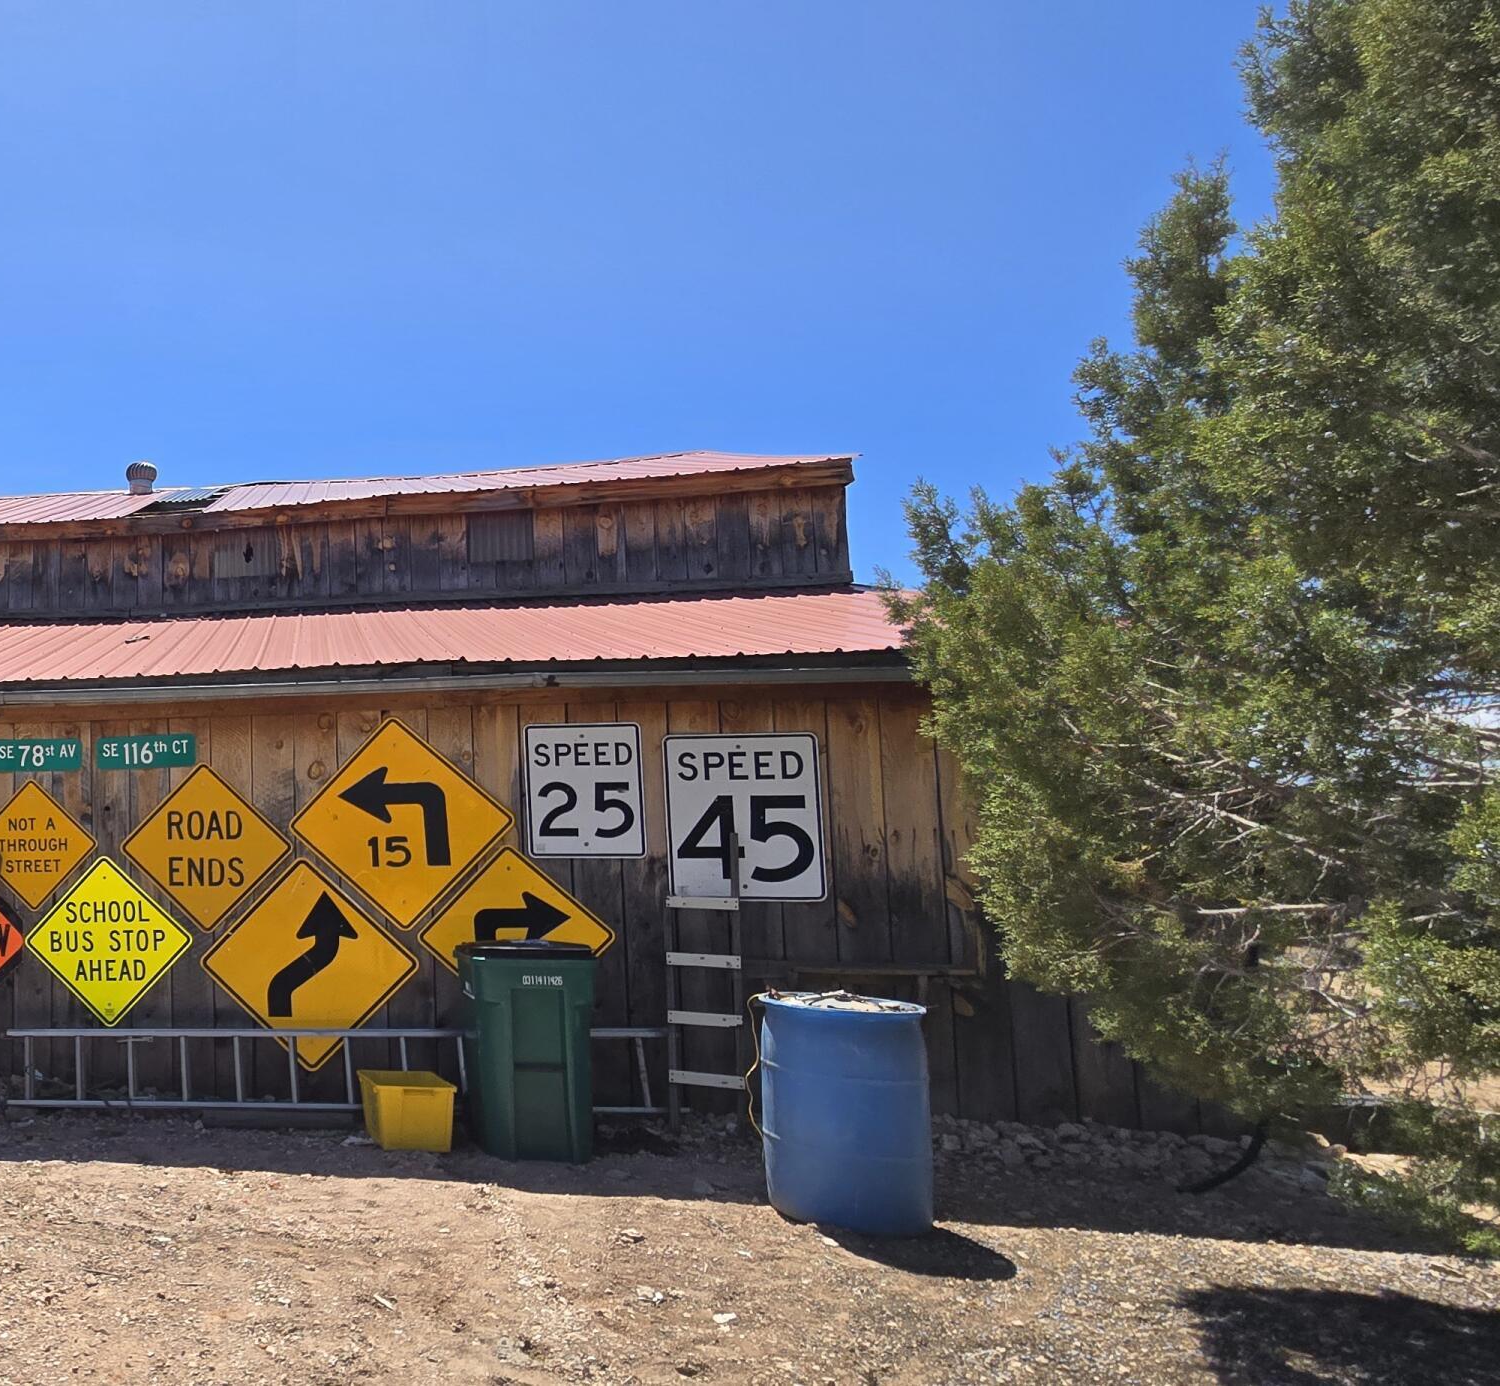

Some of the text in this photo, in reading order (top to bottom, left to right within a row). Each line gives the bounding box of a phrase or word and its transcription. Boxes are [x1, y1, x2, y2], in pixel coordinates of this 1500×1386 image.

[0, 744, 76, 767] SE 78st AV
[102, 740, 188, 765] SE 116th CT
[534, 742, 632, 767] SPEED
[678, 751, 804, 781] SPEED
[538, 781, 635, 838] 25
[8, 817, 56, 831] NOT A
[167, 810, 243, 840] ROAD
[0, 838, 68, 852] THROUGH
[677, 795, 815, 882] 45
[367, 836, 411, 868] 15
[5, 860, 61, 873] STREET
[168, 856, 245, 887] ENDS
[65, 901, 150, 923] SCHOOL
[50, 929, 166, 952] BUS STOP
[75, 960, 146, 981] AHEAD
